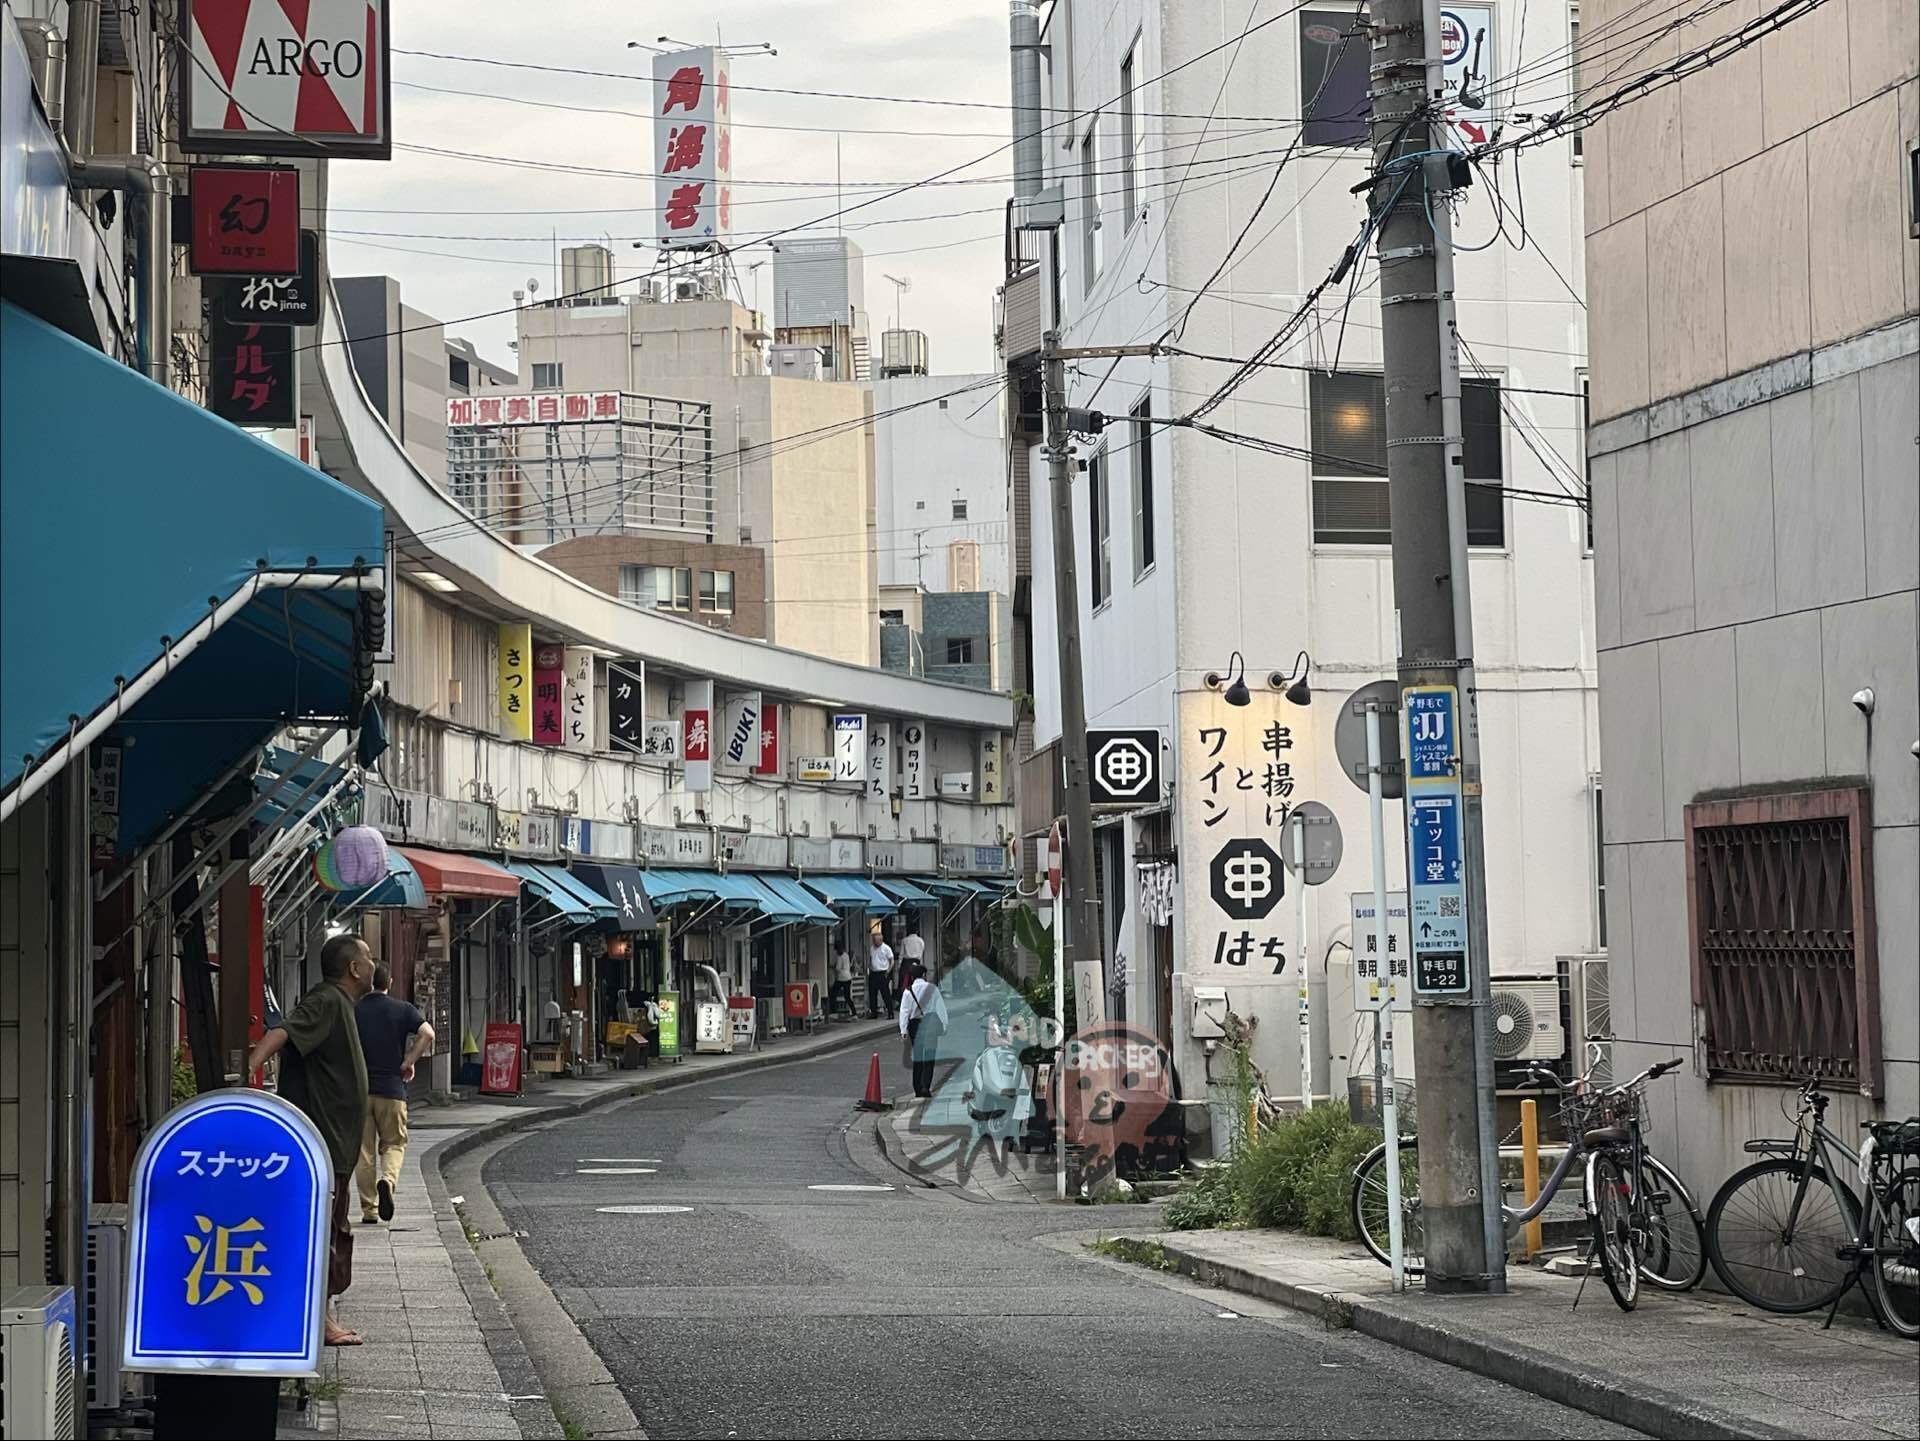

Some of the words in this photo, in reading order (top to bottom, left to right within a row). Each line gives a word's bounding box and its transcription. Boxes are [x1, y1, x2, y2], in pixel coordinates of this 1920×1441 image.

[248, 38, 362, 79] ARGO
[662, 66, 707, 230] 角海老
[218, 194, 270, 235] 幻
[279, 301, 307, 311] jinne
[449, 393, 618, 425] 加賀美自動車
[505, 648, 522, 713] さつき
[536, 682, 559, 733] 明美
[570, 691, 586, 744] さち
[616, 682, 634, 728] カン
[1415, 711, 1447, 741] JJ
[686, 717, 708, 753] 舞
[727, 706, 758, 762] IBUKI
[840, 733, 858, 777] イル
[1198, 727, 1230, 828] ワイン
[1235, 767, 1254, 790] と
[1261, 720, 1295, 828] 串揚げ
[1425, 809, 1445, 882] コッコ堂
[1213, 930, 1287, 975] はち
[1422, 959, 1457, 971] 野毛町
[1425, 974, 1457, 986] 1-22
[177, 1150, 290, 1180] スナック
[183, 1214, 272, 1306] 浜
